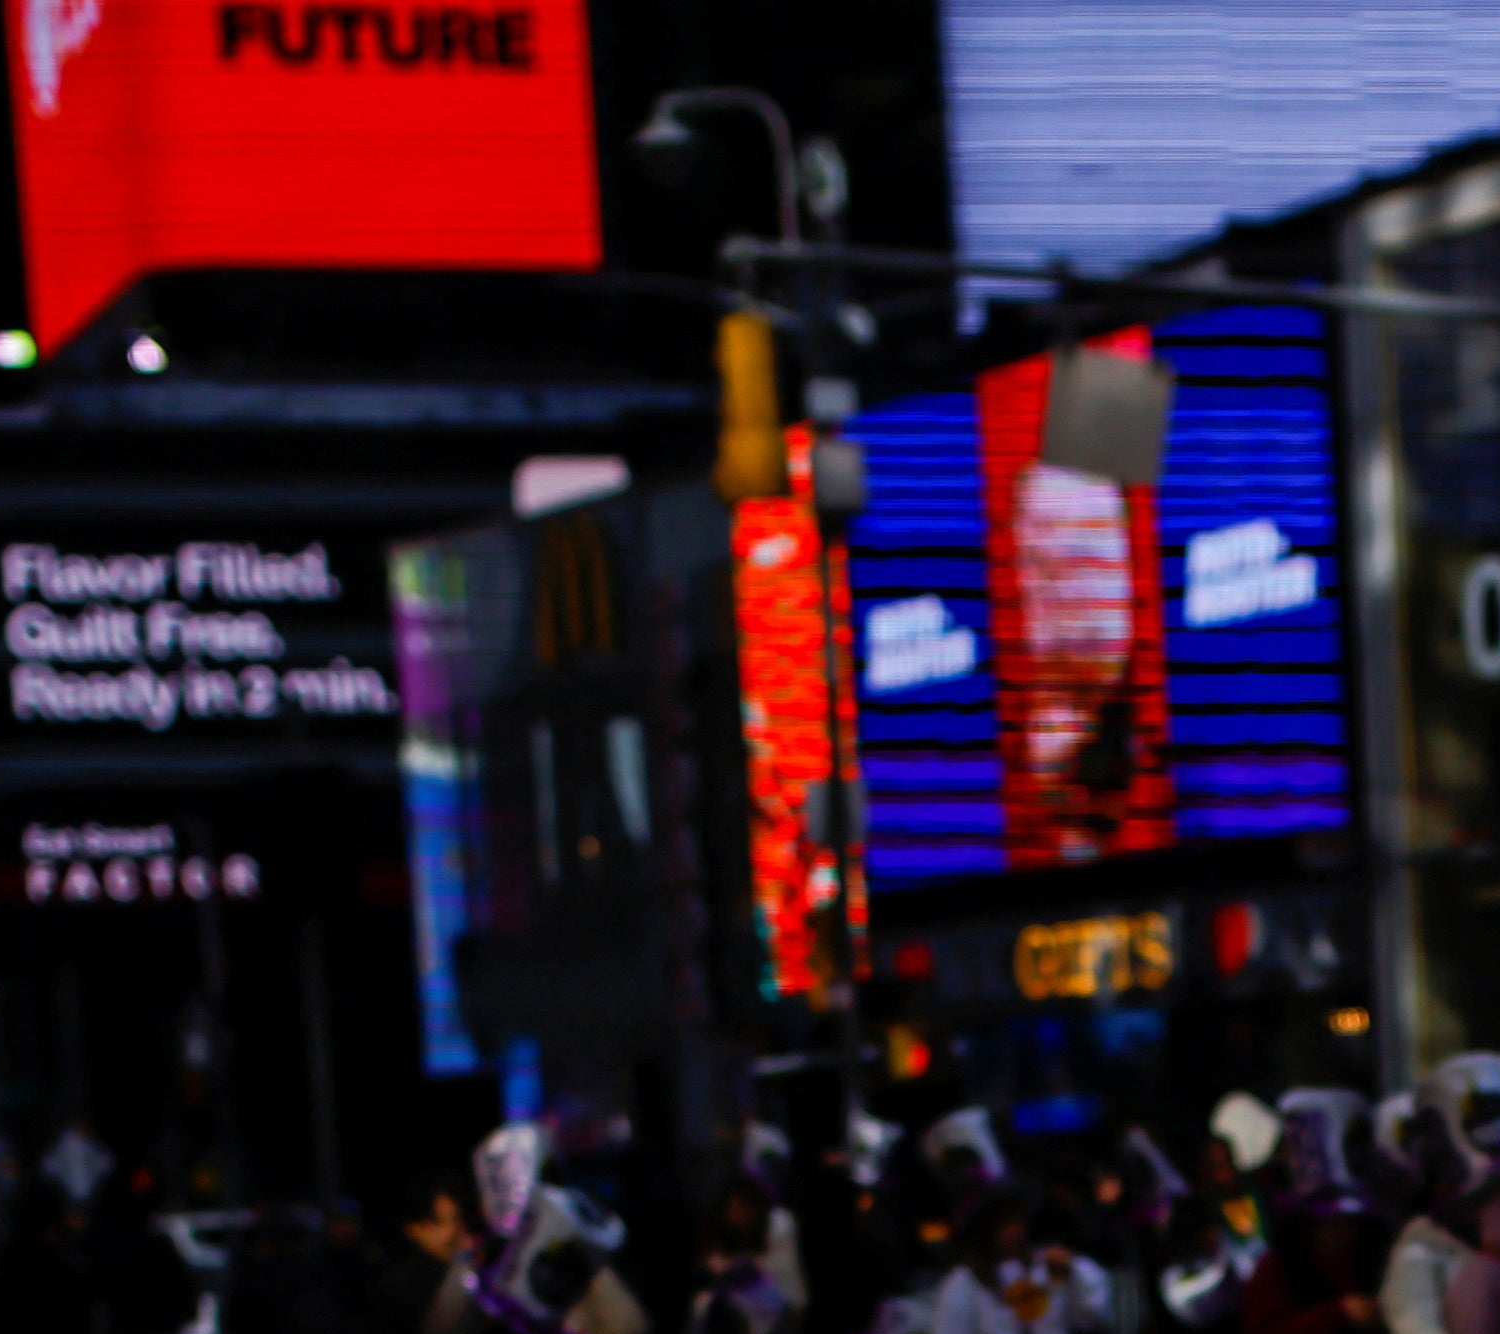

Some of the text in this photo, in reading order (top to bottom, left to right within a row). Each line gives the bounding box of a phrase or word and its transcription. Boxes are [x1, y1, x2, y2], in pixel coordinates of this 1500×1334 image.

[219, 5, 537, 72] FUTURE
[3, 542, 341, 602] Flavor Filled.
[148, 606, 283, 658] Free.
[12, 663, 175, 730] Ready
[186, 661, 233, 715] in
[238, 665, 277, 716] 2
